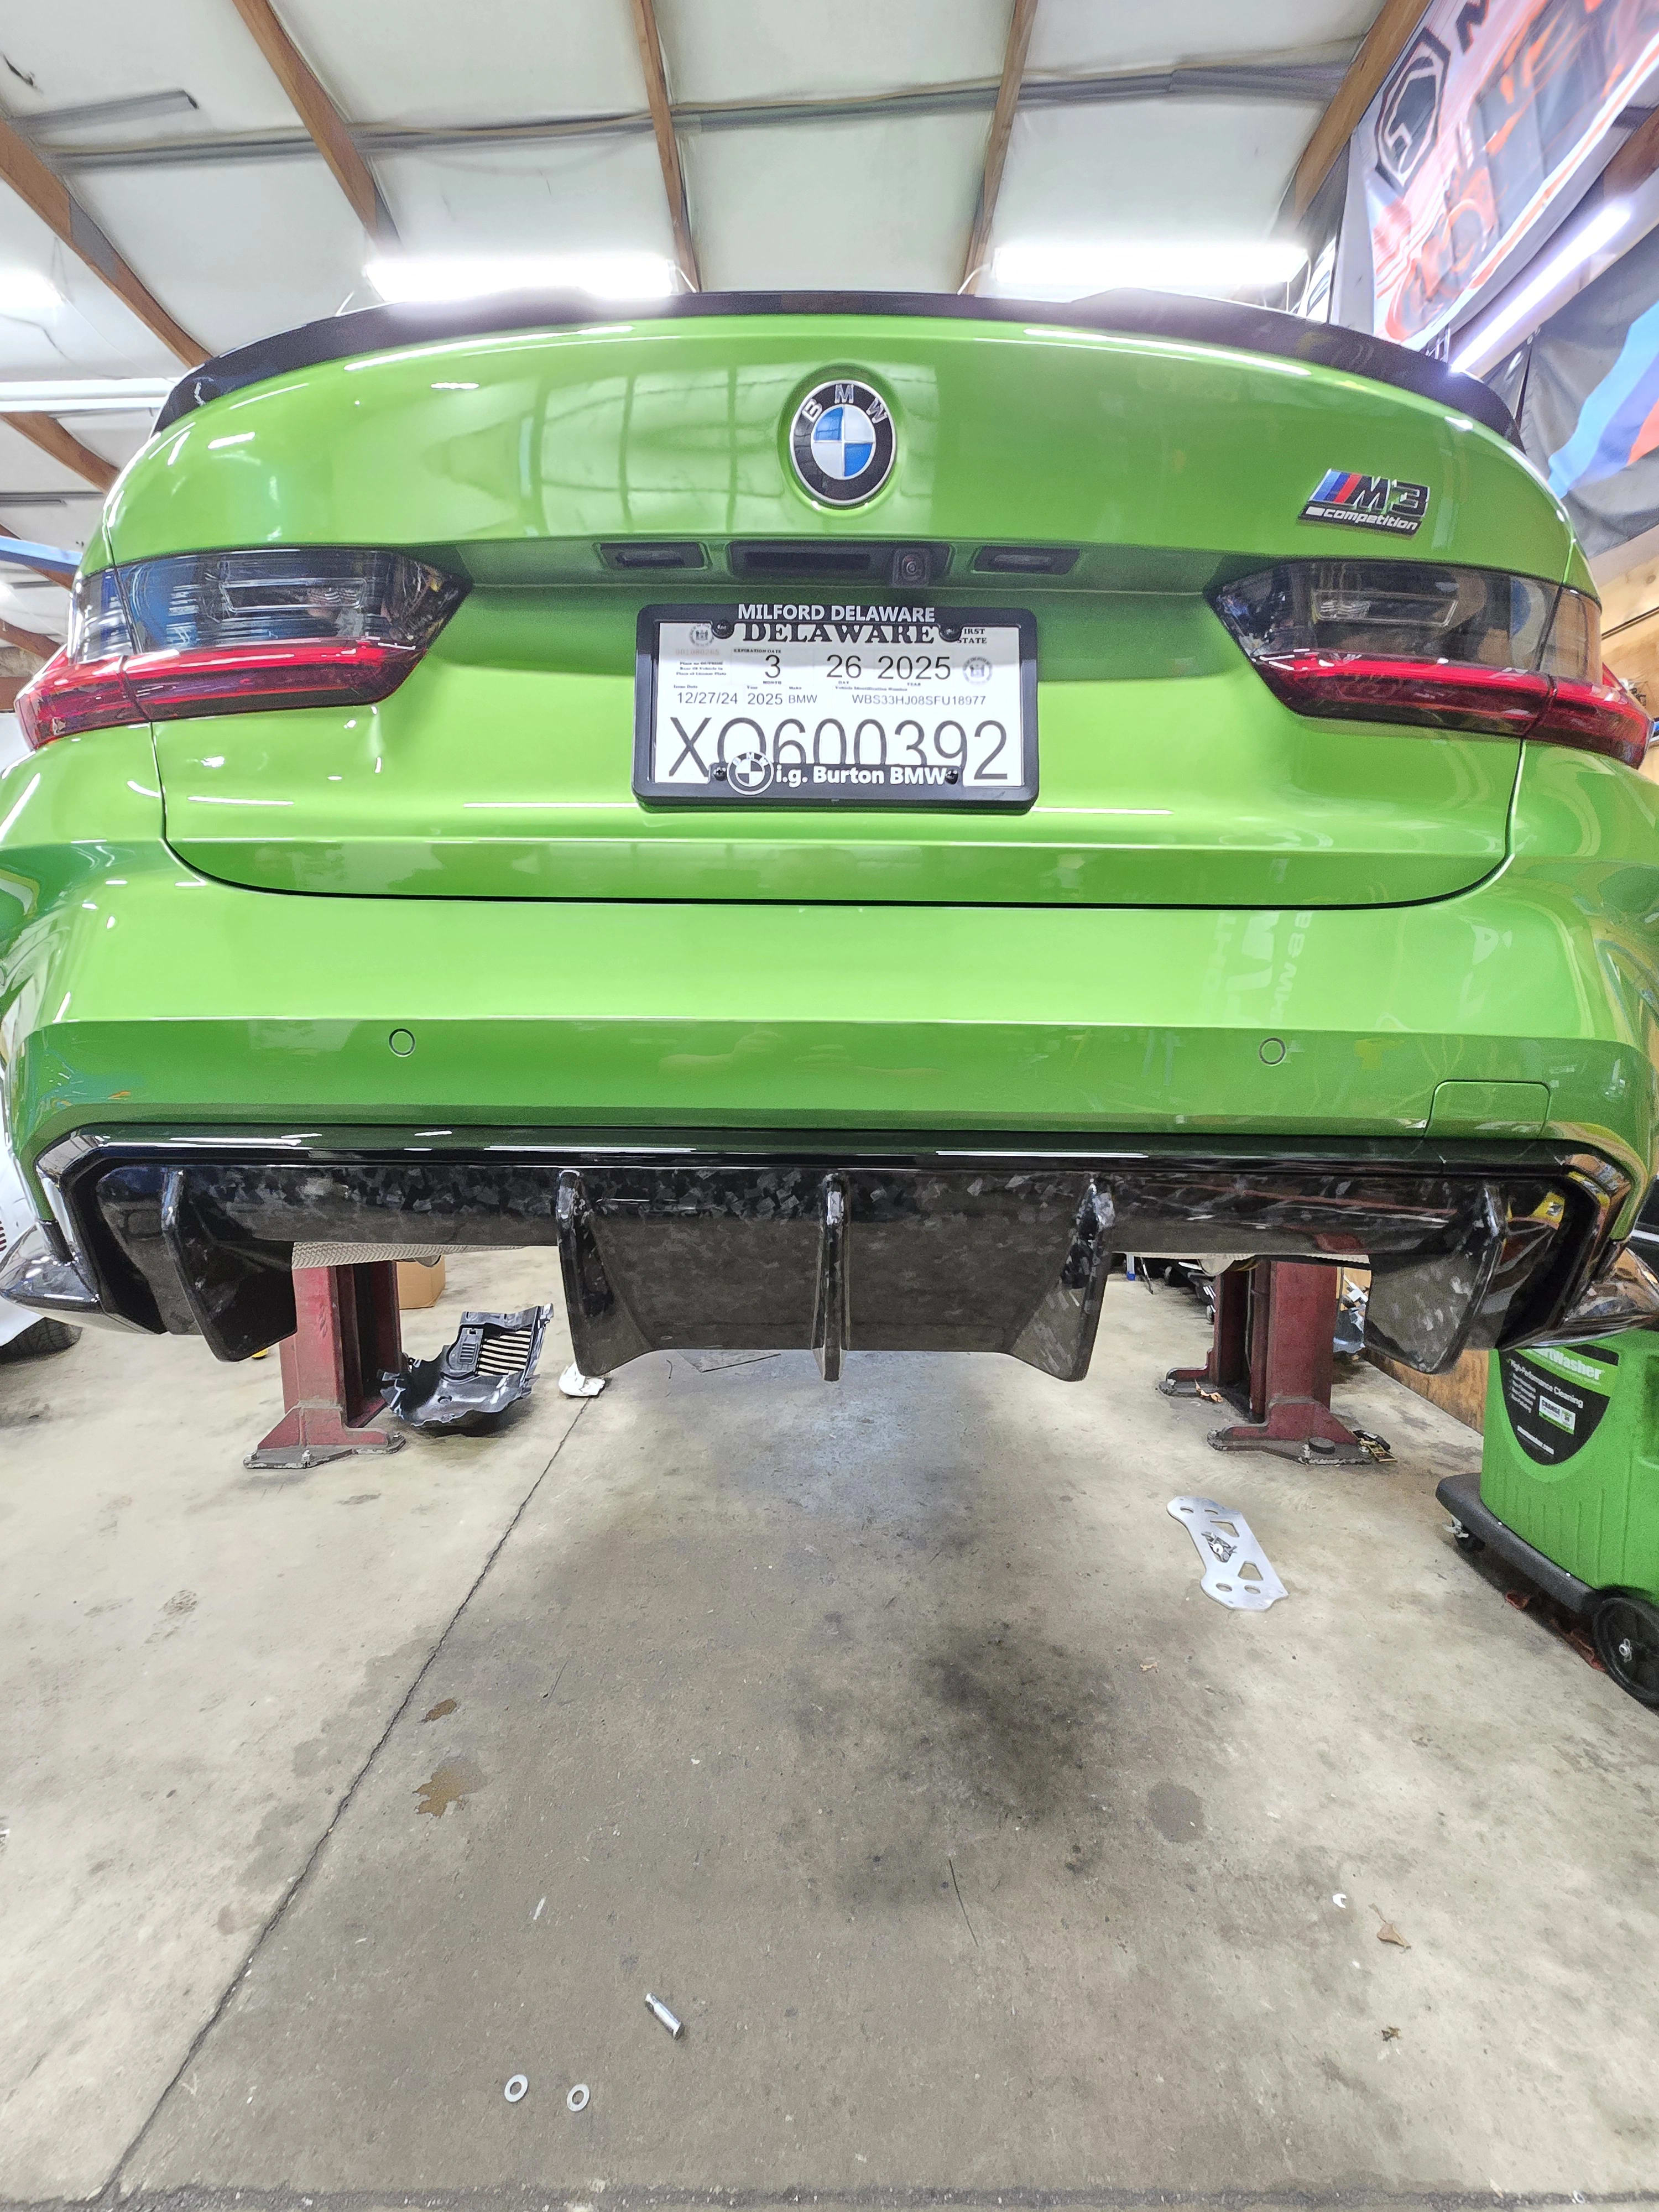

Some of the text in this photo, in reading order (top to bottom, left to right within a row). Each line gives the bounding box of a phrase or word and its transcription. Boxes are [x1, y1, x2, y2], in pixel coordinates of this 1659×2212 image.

[802, 384, 888, 424] BMW
[1344, 474, 1430, 518] M3
[1323, 509, 1418, 530] competition
[738, 603, 935, 622] MILFORD DELAWARE
[743, 623, 935, 644] DELAWARE
[765, 654, 781, 679] 3
[826, 654, 862, 679] 26
[877, 655, 951, 680] 2025
[677, 691, 738, 705] 12/27/24
[747, 692, 783, 706] 2025
[788, 694, 818, 704] BMW
[776, 764, 947, 788] i.g. Burton BMW
[1531, 1348, 1603, 1380] rtWasher
[1553, 1386, 1584, 1409] Cleaning
